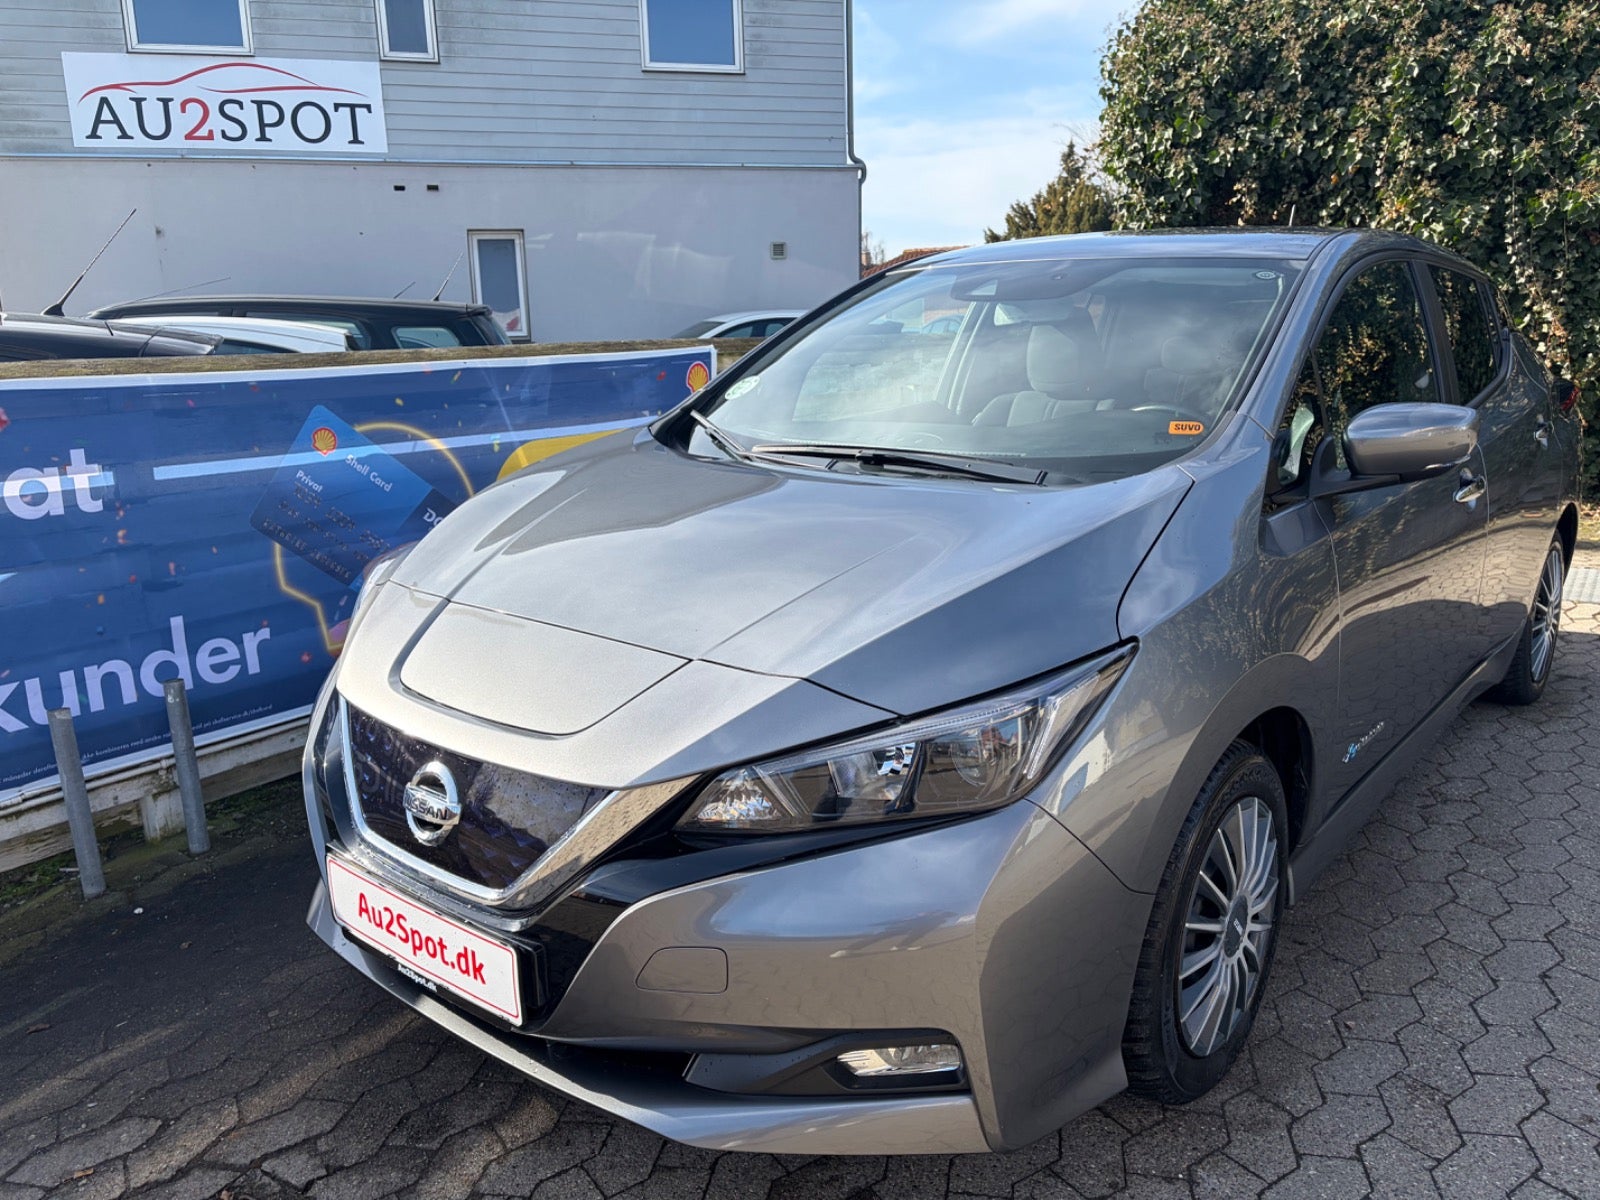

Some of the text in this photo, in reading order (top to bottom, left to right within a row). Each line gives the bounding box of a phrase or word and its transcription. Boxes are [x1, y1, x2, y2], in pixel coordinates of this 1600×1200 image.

[85, 96, 373, 145] AU2SPOT
[1174, 423, 1201, 431] SUVO
[3, 448, 104, 521] at
[296, 469, 323, 493] Privat
[345, 454, 393, 493] Shell Card
[404, 788, 449, 821] NISSAN
[357, 892, 486, 985] Au2Spot.dk
